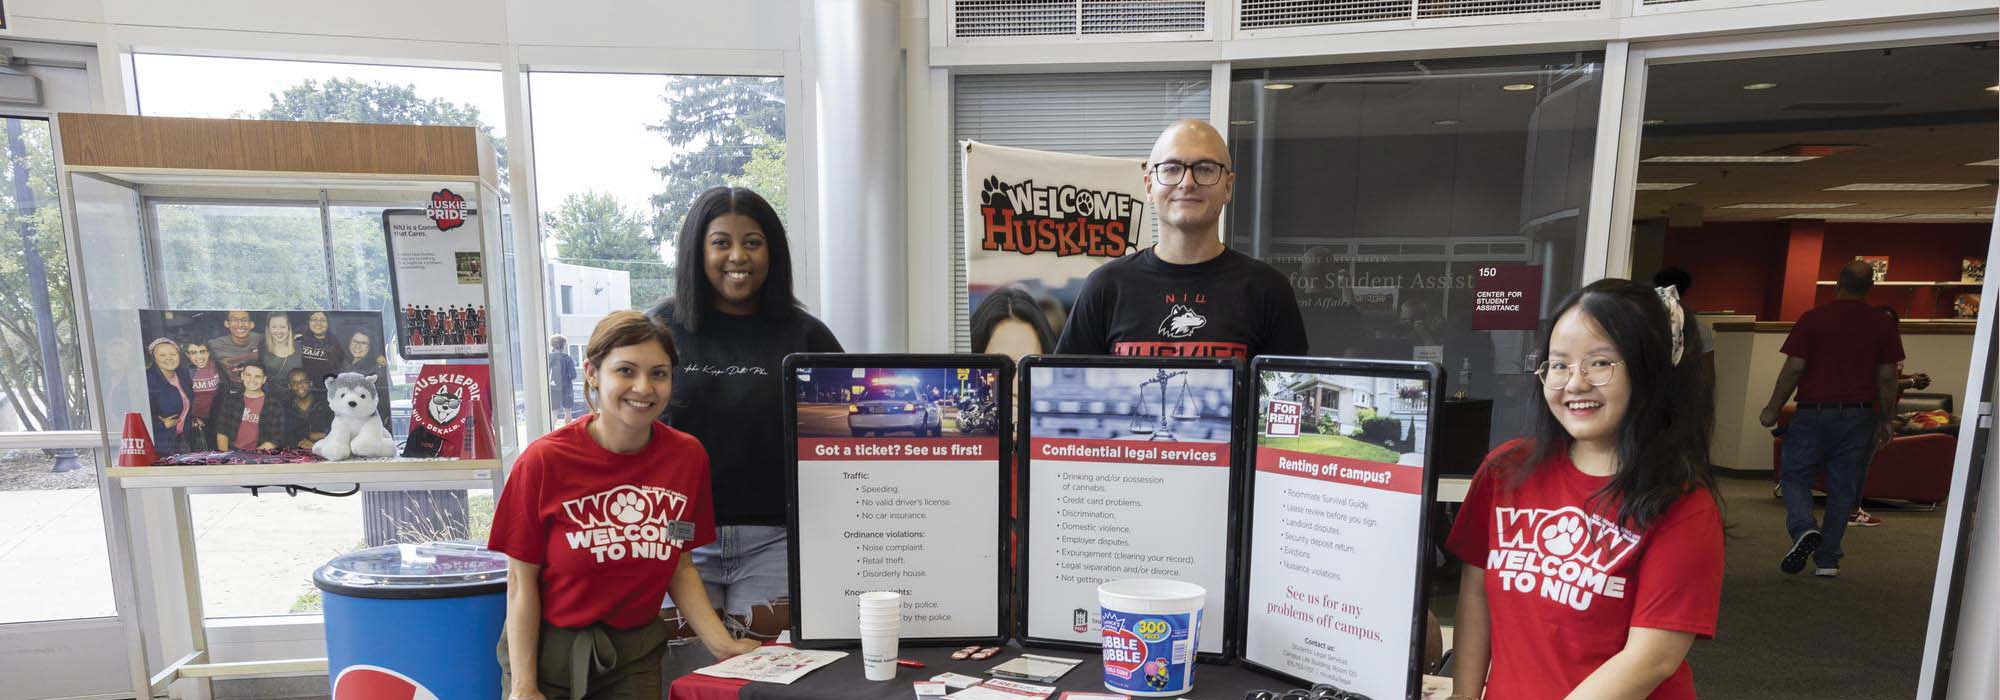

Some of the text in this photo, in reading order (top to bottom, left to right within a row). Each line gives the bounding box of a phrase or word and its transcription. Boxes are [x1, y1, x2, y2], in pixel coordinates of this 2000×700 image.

[426, 210, 468, 220] PRIDE
[1479, 267, 1497, 277] 150
[1289, 271, 1473, 289] for Student Assist
[1164, 293, 1207, 303] NIU
[1273, 402, 1296, 414] FOR
[1269, 413, 1298, 424] RENT
[120, 438, 144, 449] NIU
[815, 444, 982, 456] Got a ticket? See us first!
[1042, 444, 1217, 462] Confidential legal services
[843, 472, 870, 480] Traffic:
[1279, 456, 1392, 484] Renting off campus?
[1062, 472, 1164, 485] Drinking and/or possession
[875, 498, 894, 506] valid
[1062, 496, 1085, 504] Credit
[1105, 498, 1143, 508] problems.
[1305, 507, 1325, 517] review
[1326, 509, 1347, 520] before
[1348, 514, 1361, 524] you
[1062, 523, 1096, 531] Domestic
[1286, 518, 1313, 530] Landlord
[843, 531, 926, 539] Ordinance violations:
[1061, 535, 1130, 547] Employer disputes.
[1285, 532, 1309, 545] Security
[1310, 537, 1334, 550] deposit
[590, 542, 671, 563] TO NIU
[885, 543, 925, 553] complaint.
[1061, 549, 1112, 560] Expungement
[1114, 551, 1146, 562] (clearing
[1147, 555, 1163, 563] your
[862, 569, 927, 578] Disorderly house.
[1061, 561, 1181, 576] Legal separation and/or divorce.
[1061, 574, 1074, 582] Not
[1076, 575, 1103, 585] getting
[1499, 570, 1593, 611] TO NIU
[903, 601, 938, 609] by police.
[1286, 585, 1363, 620] See us for any
[903, 613, 912, 622] by
[914, 613, 927, 621] the
[1267, 601, 1383, 643] problems off campus.
[1138, 619, 1167, 634] 300
[1304, 637, 1326, 649] Contact
